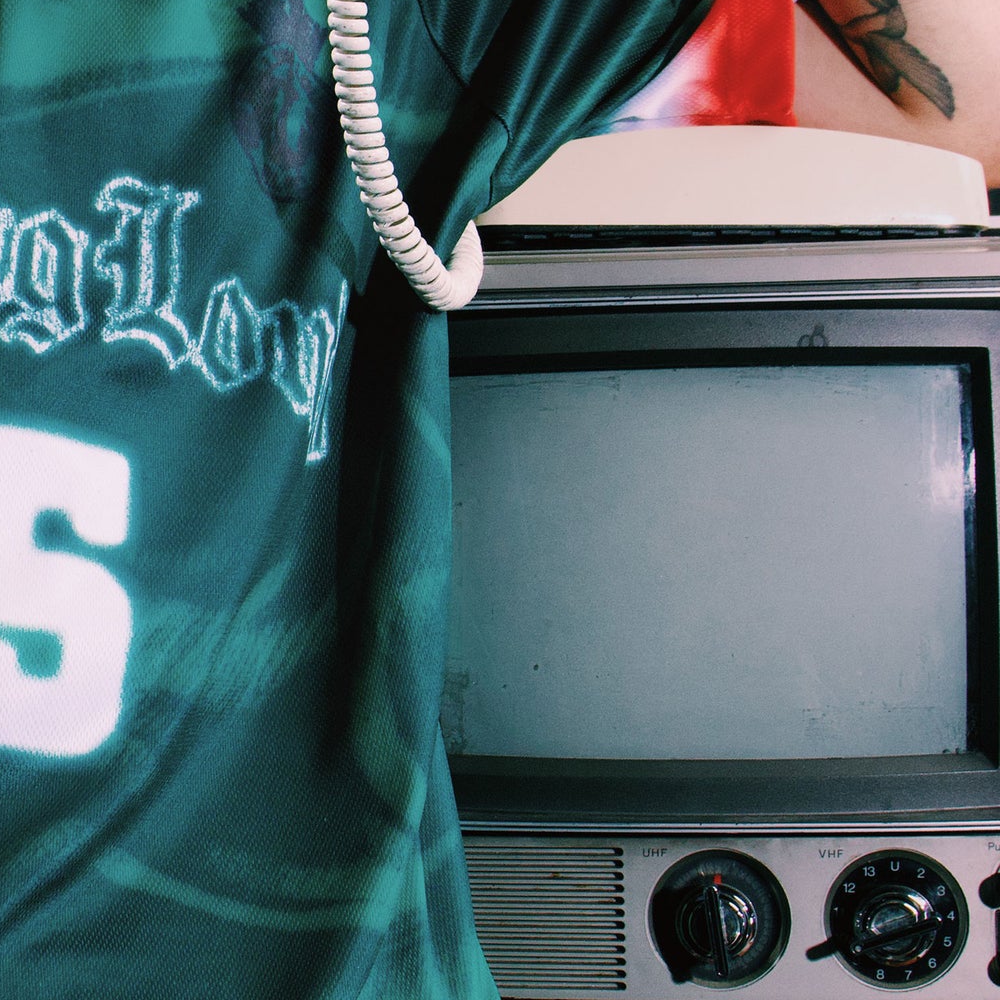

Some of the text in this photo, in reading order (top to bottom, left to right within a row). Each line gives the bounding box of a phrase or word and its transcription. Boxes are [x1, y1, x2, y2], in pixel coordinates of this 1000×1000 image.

[642, 848, 668, 858] UHF
[818, 849, 844, 859] VHF
[862, 866, 876, 877] 13
[890, 861, 900, 872] U
[917, 868, 926, 878] 2
[843, 882, 856, 893] 12
[937, 886, 946, 896] 3
[947, 911, 955, 920] 4
[943, 936, 952, 947] 5
[928, 958, 937, 968] 6
[876, 969, 885, 980] 8
[904, 970, 913, 980] 7
